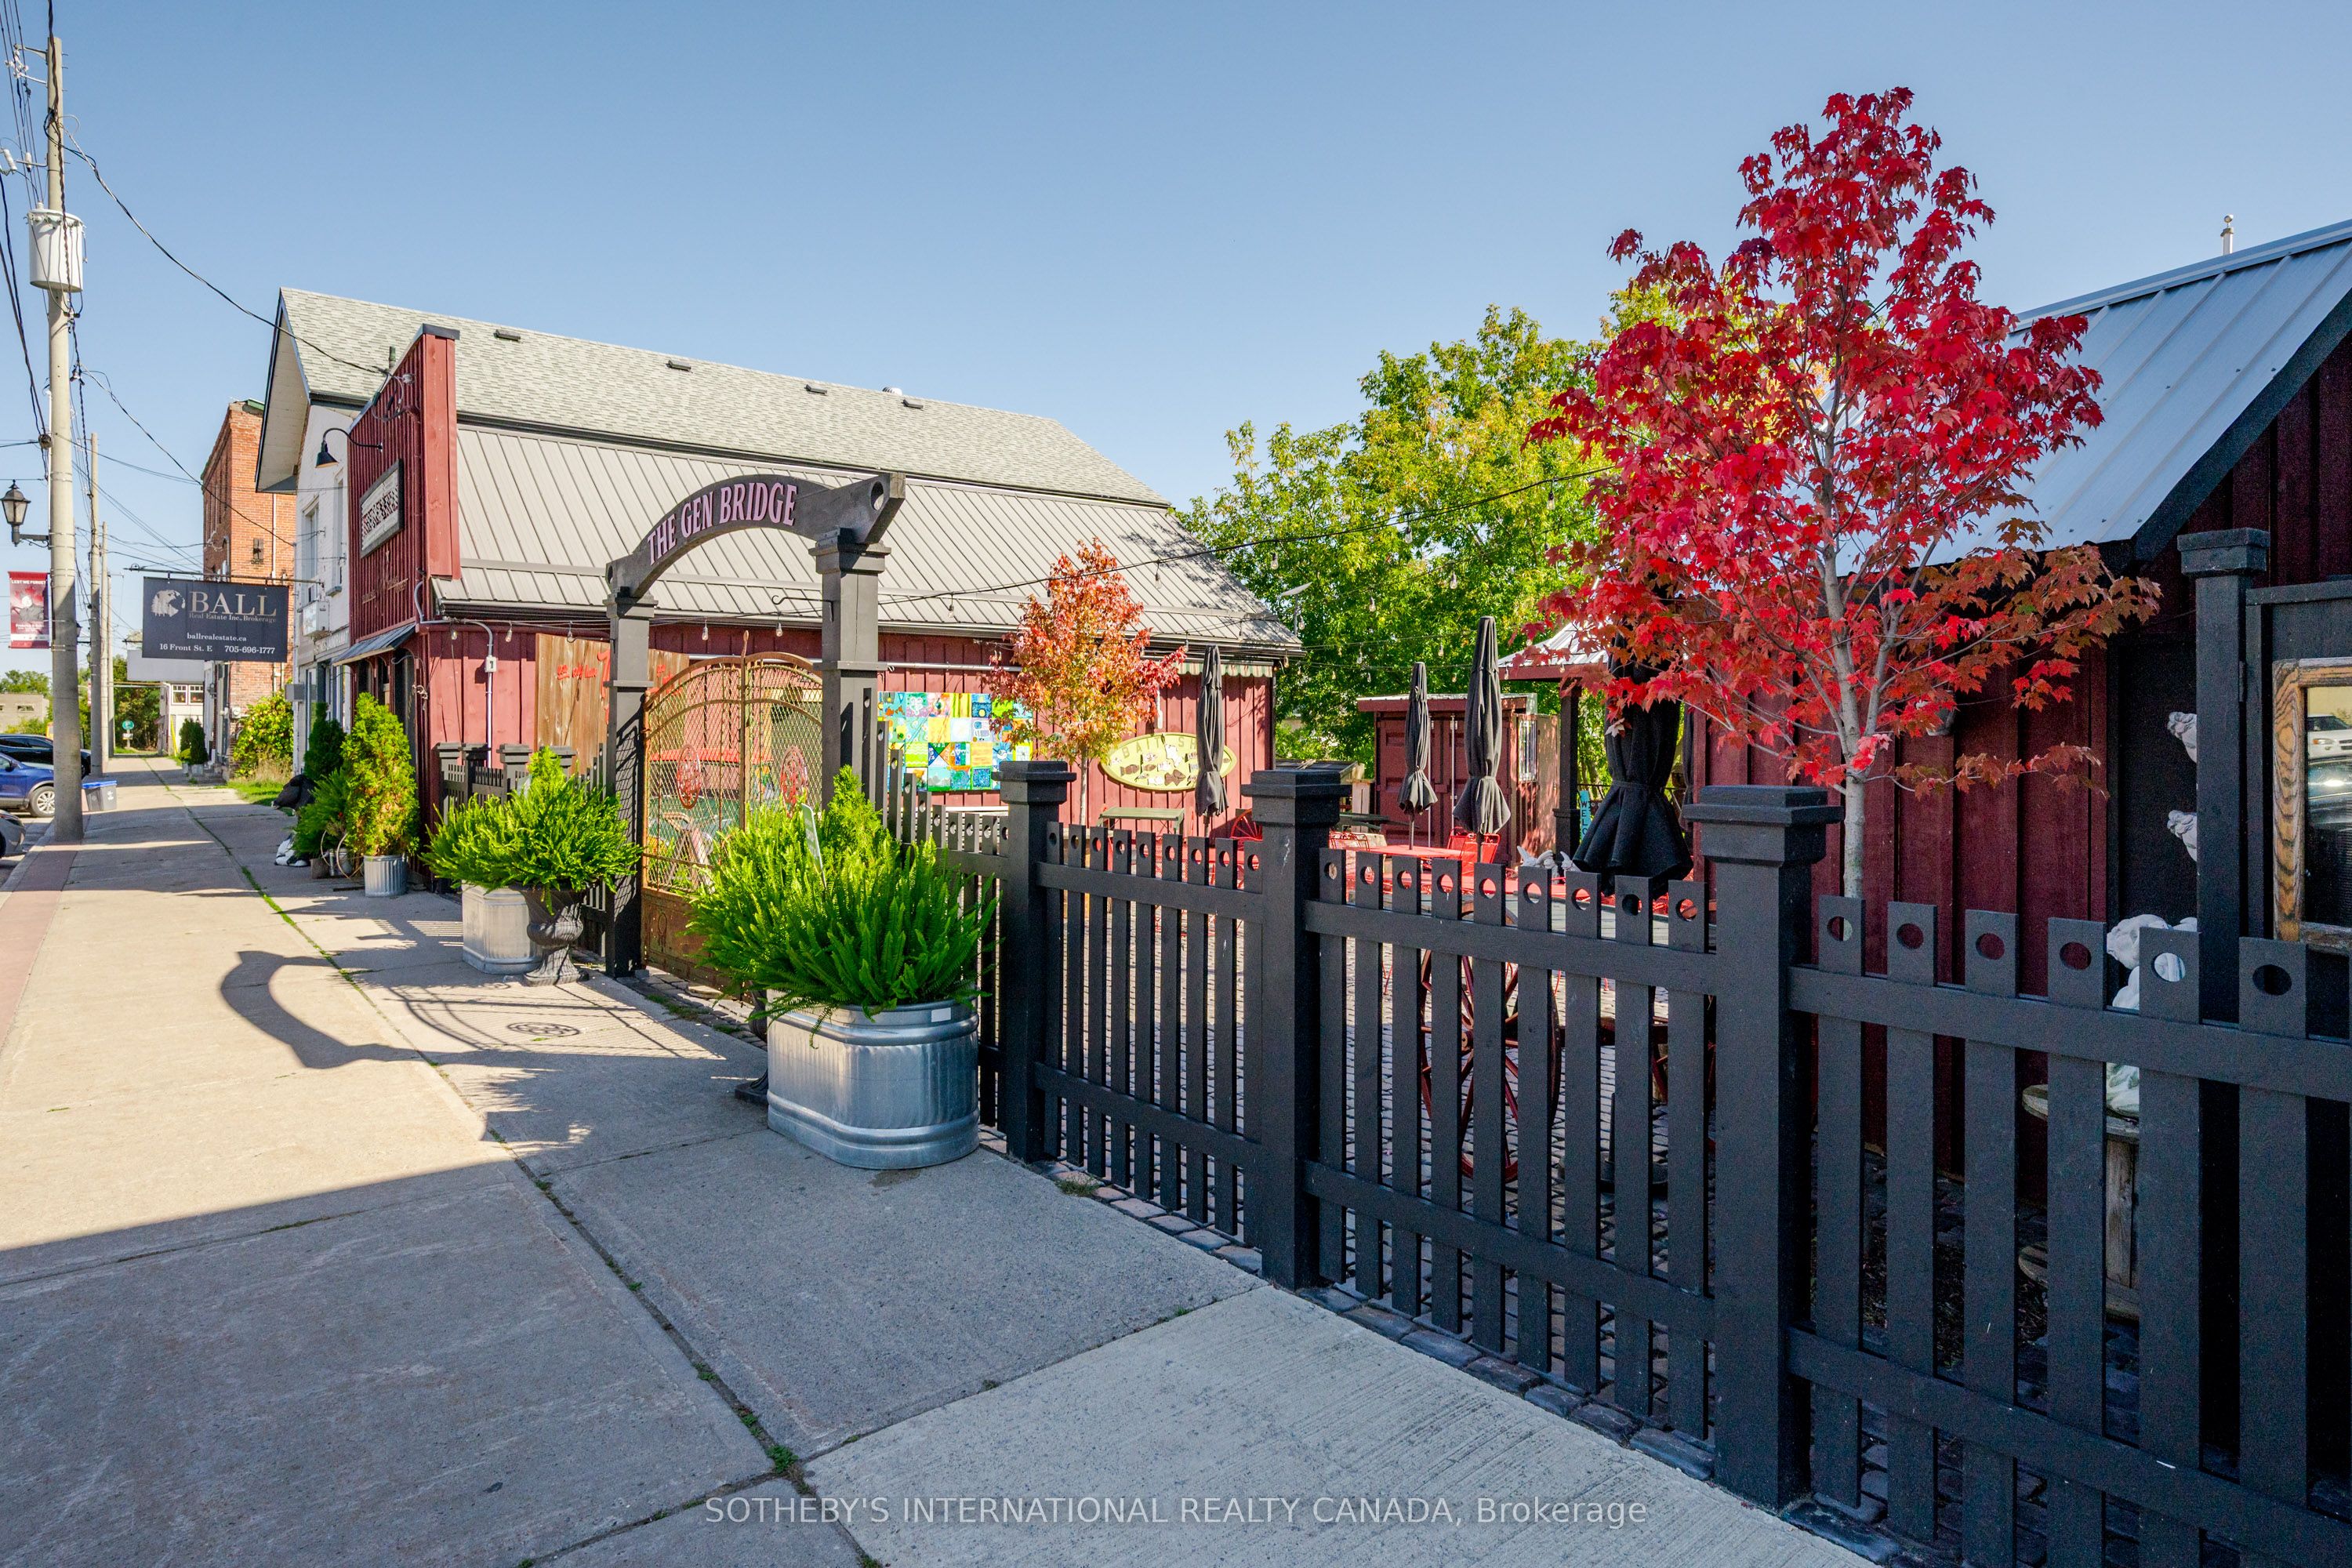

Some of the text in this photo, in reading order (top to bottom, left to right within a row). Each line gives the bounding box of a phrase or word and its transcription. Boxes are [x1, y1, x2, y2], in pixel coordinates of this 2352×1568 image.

[647, 482, 797, 566] THE GEN BRIDGE
[189, 591, 277, 616] BALL
[243, 615, 277, 624] Brokerage
[187, 632, 247, 642] ballrealestate.ca
[224, 645, 276, 654] 705-696-1777
[1123, 737, 1197, 758] BAIT SH
